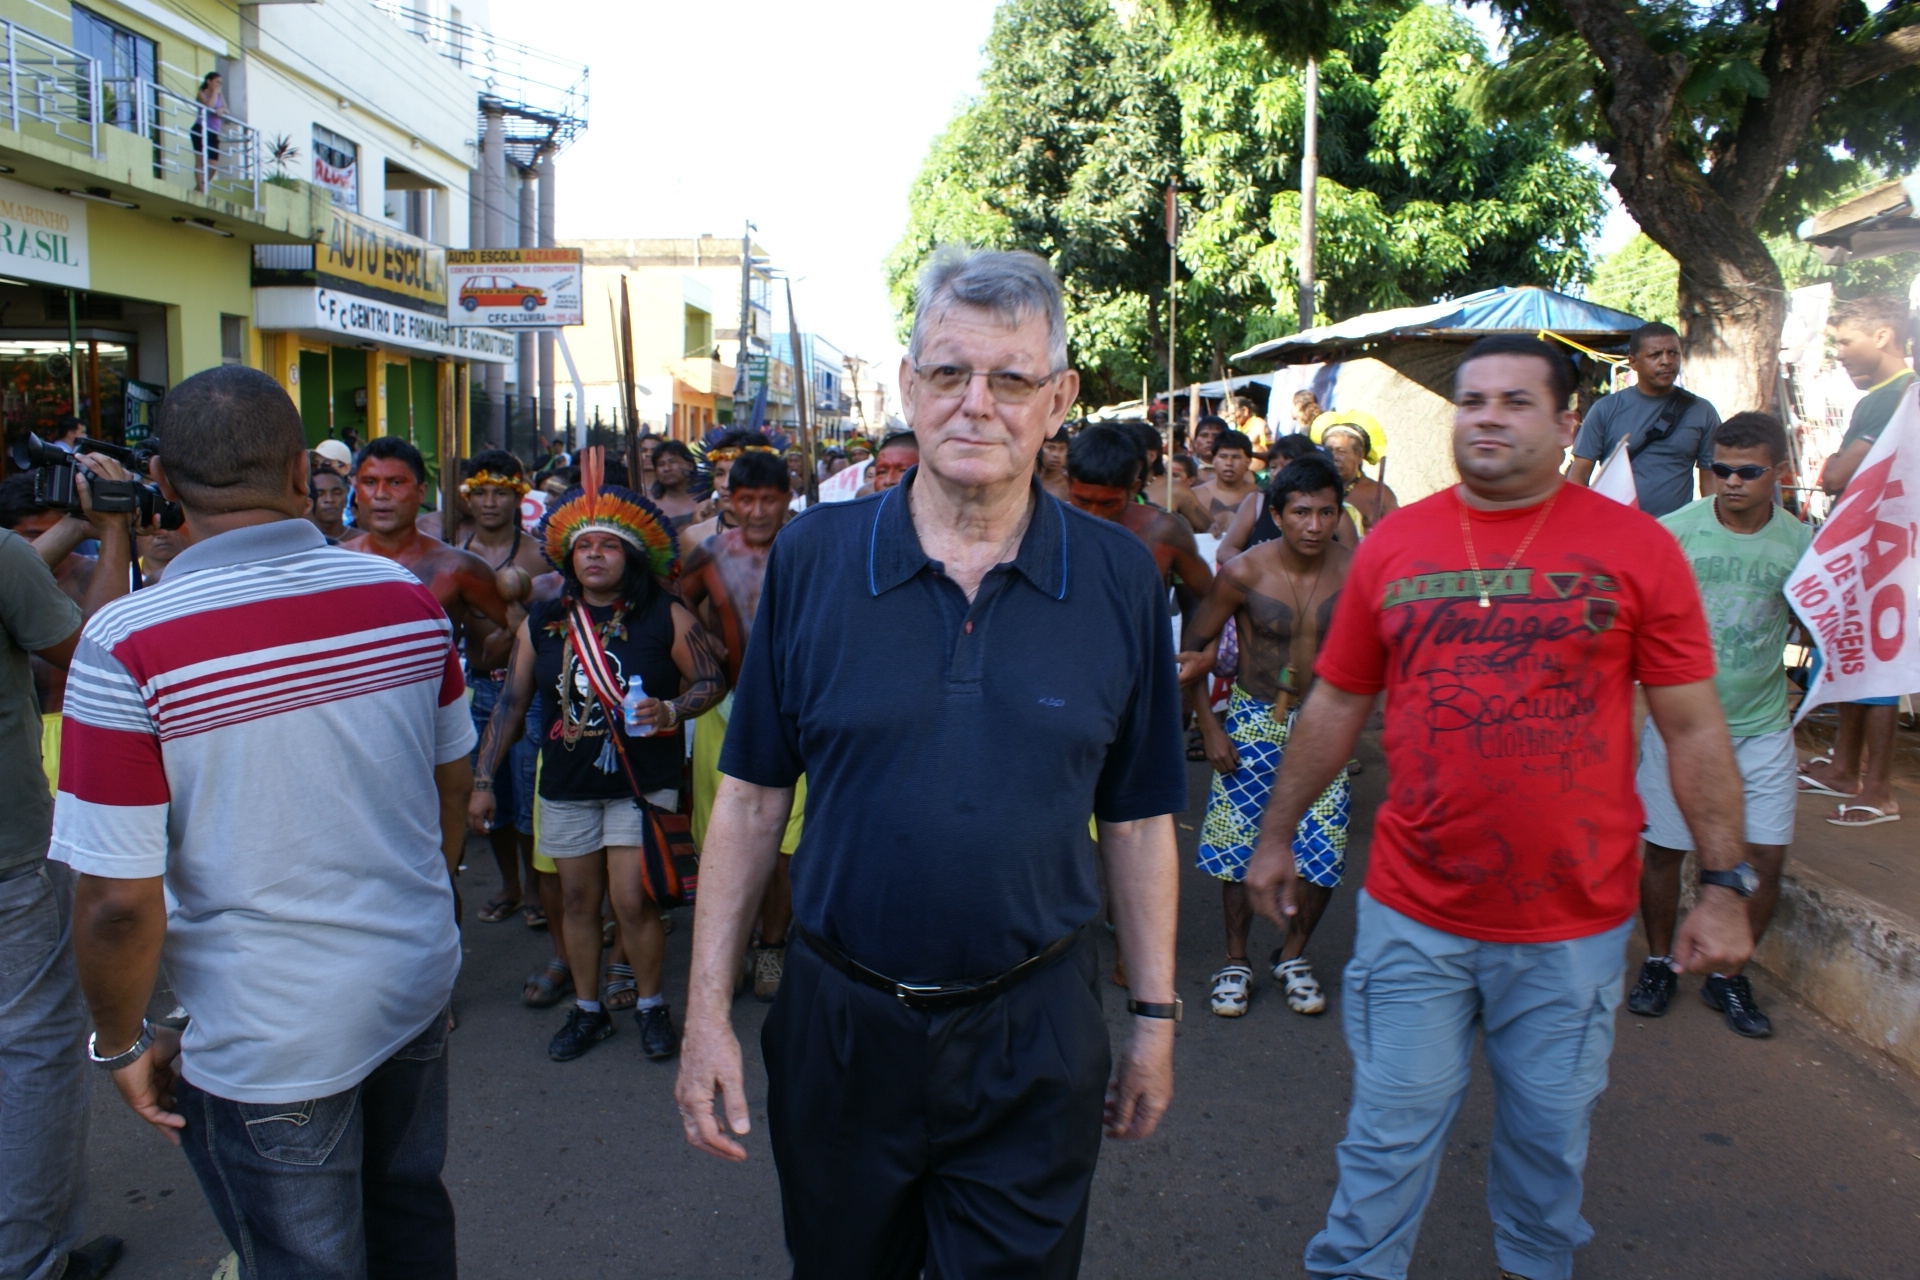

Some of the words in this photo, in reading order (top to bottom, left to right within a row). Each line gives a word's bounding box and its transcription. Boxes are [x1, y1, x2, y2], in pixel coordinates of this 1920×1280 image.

[329, 216, 379, 276] AUTO
[382, 234, 447, 296] ESCOLA
[448, 250, 476, 263] AUTO
[480, 250, 522, 263] ESCOLA
[523, 250, 579, 263] ALTAMIRA
[450, 265, 474, 274] CENTRO
[475, 265, 484, 274] DE
[522, 265, 531, 273] DE
[533, 265, 576, 273] CONDUTORES
[350, 303, 390, 335] CENTRO
[394, 311, 406, 337] DE
[459, 328, 469, 350] DE
[470, 330, 515, 357] CONDUTORES
[487, 312, 509, 324] CFC
[510, 312, 547, 324] ALTAMIRA
[1813, 450, 1918, 665] NÃO
[1824, 552, 1858, 588] DE
[1790, 574, 1829, 608] NO
